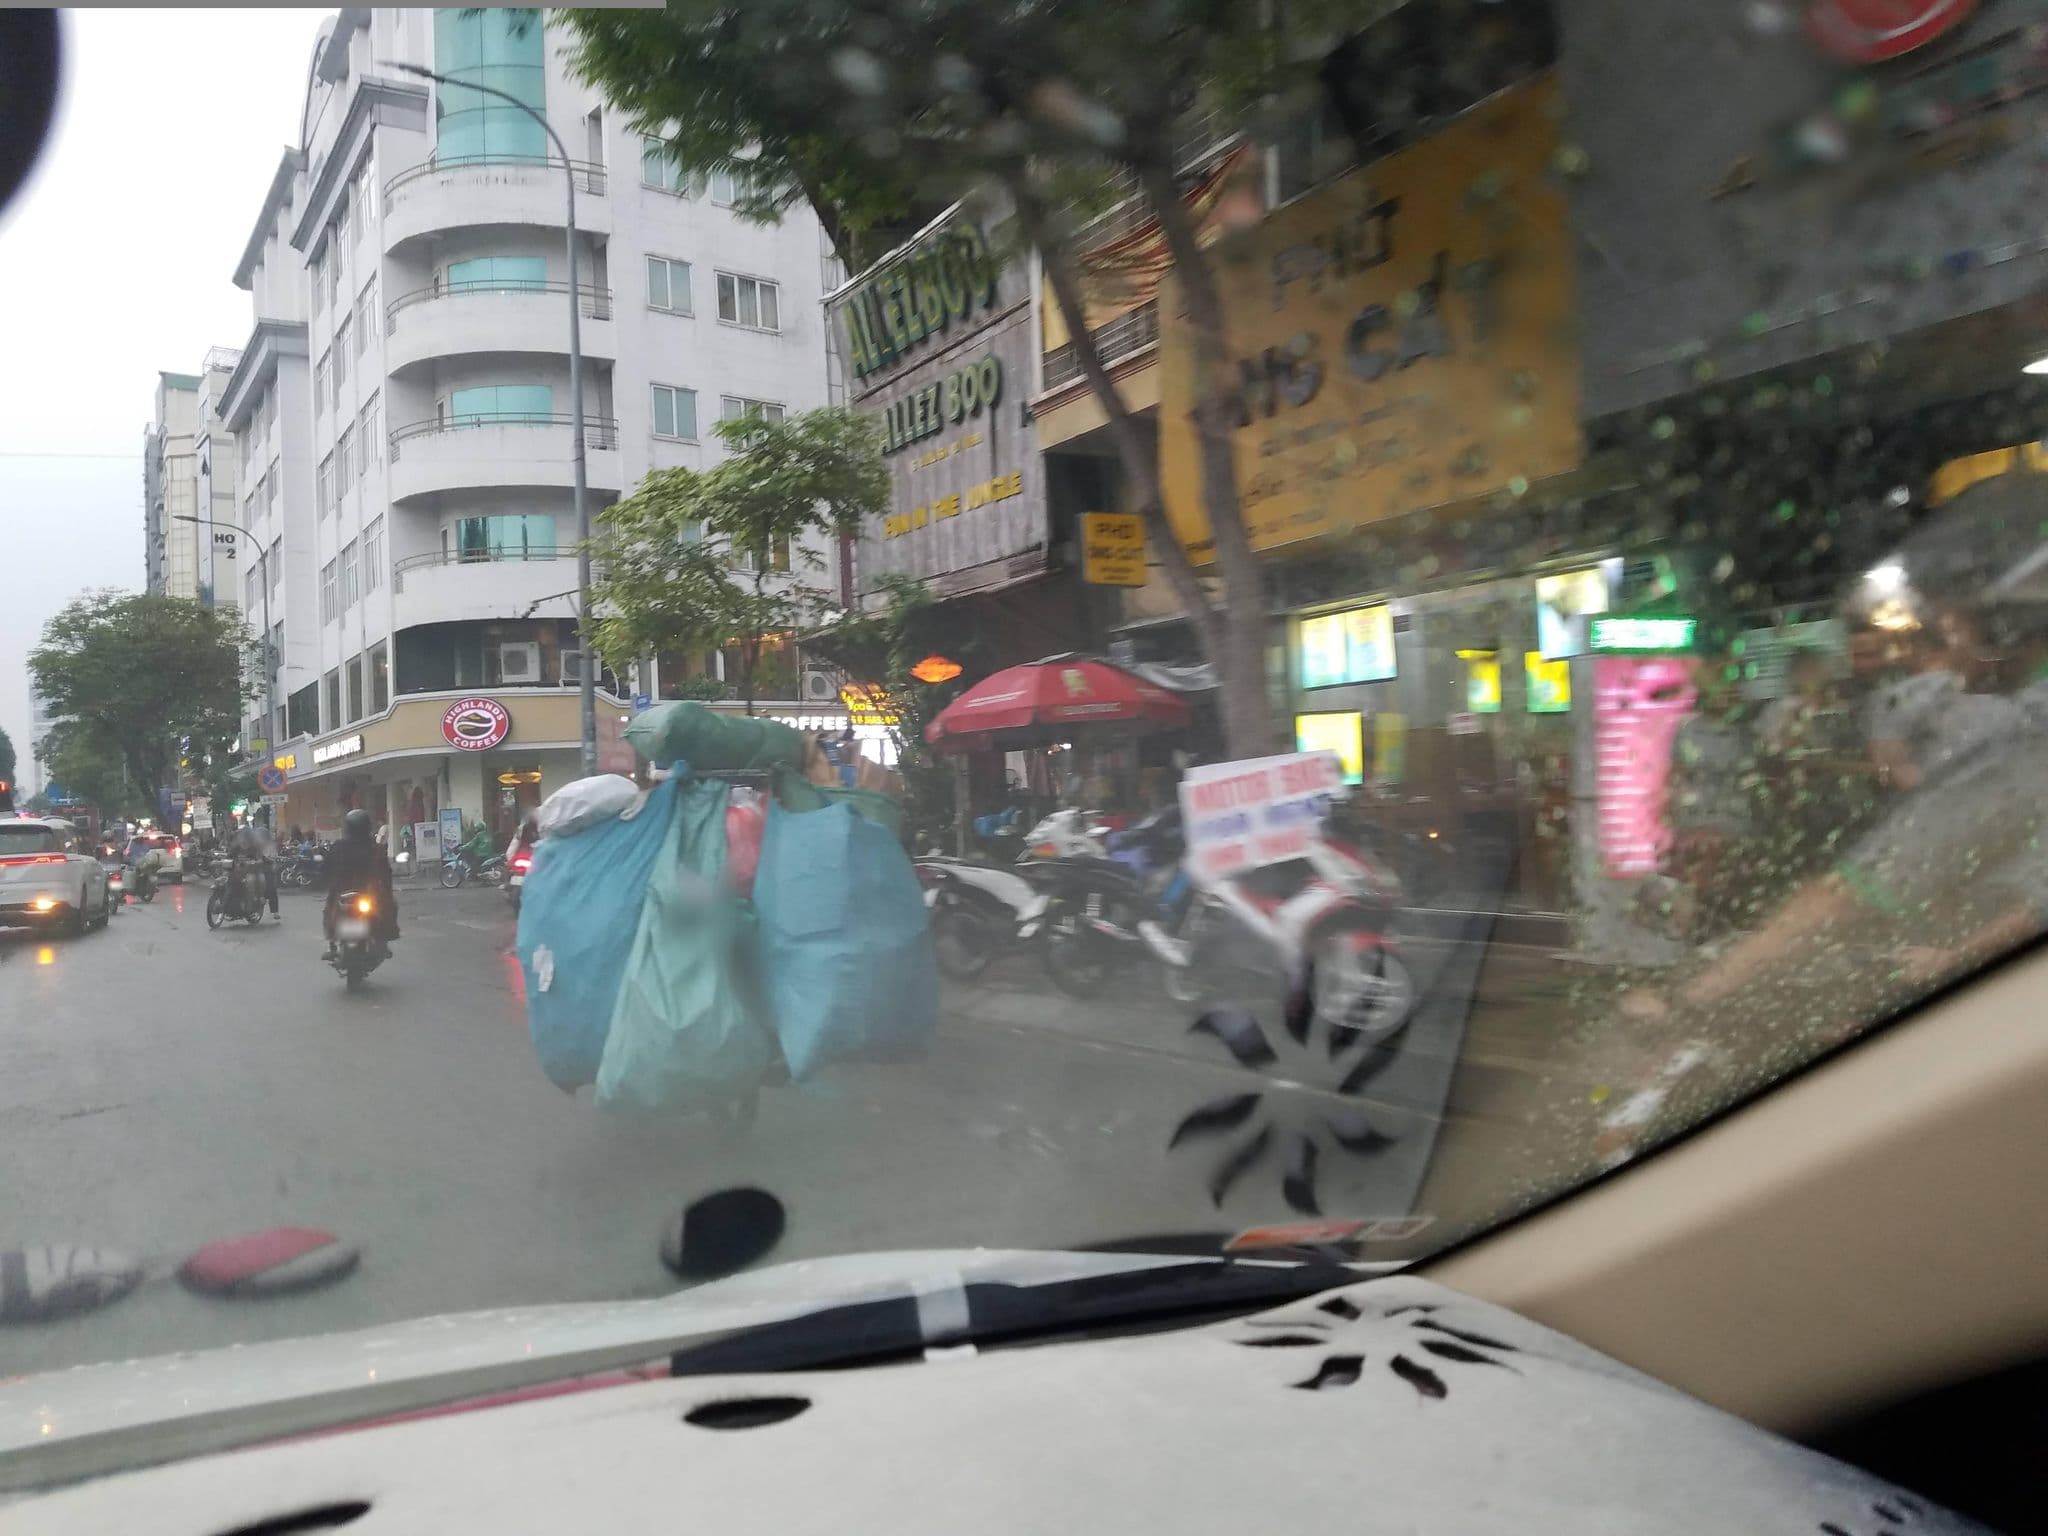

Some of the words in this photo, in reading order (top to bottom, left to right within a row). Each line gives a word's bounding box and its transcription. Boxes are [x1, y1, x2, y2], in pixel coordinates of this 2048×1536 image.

[948, 355, 998, 422] BOO
[226, 548, 236, 559] 2
[444, 701, 505, 724] HIGHLANDS
[769, 716, 848, 731] OFFEE
[452, 733, 499, 748] COFFEE
